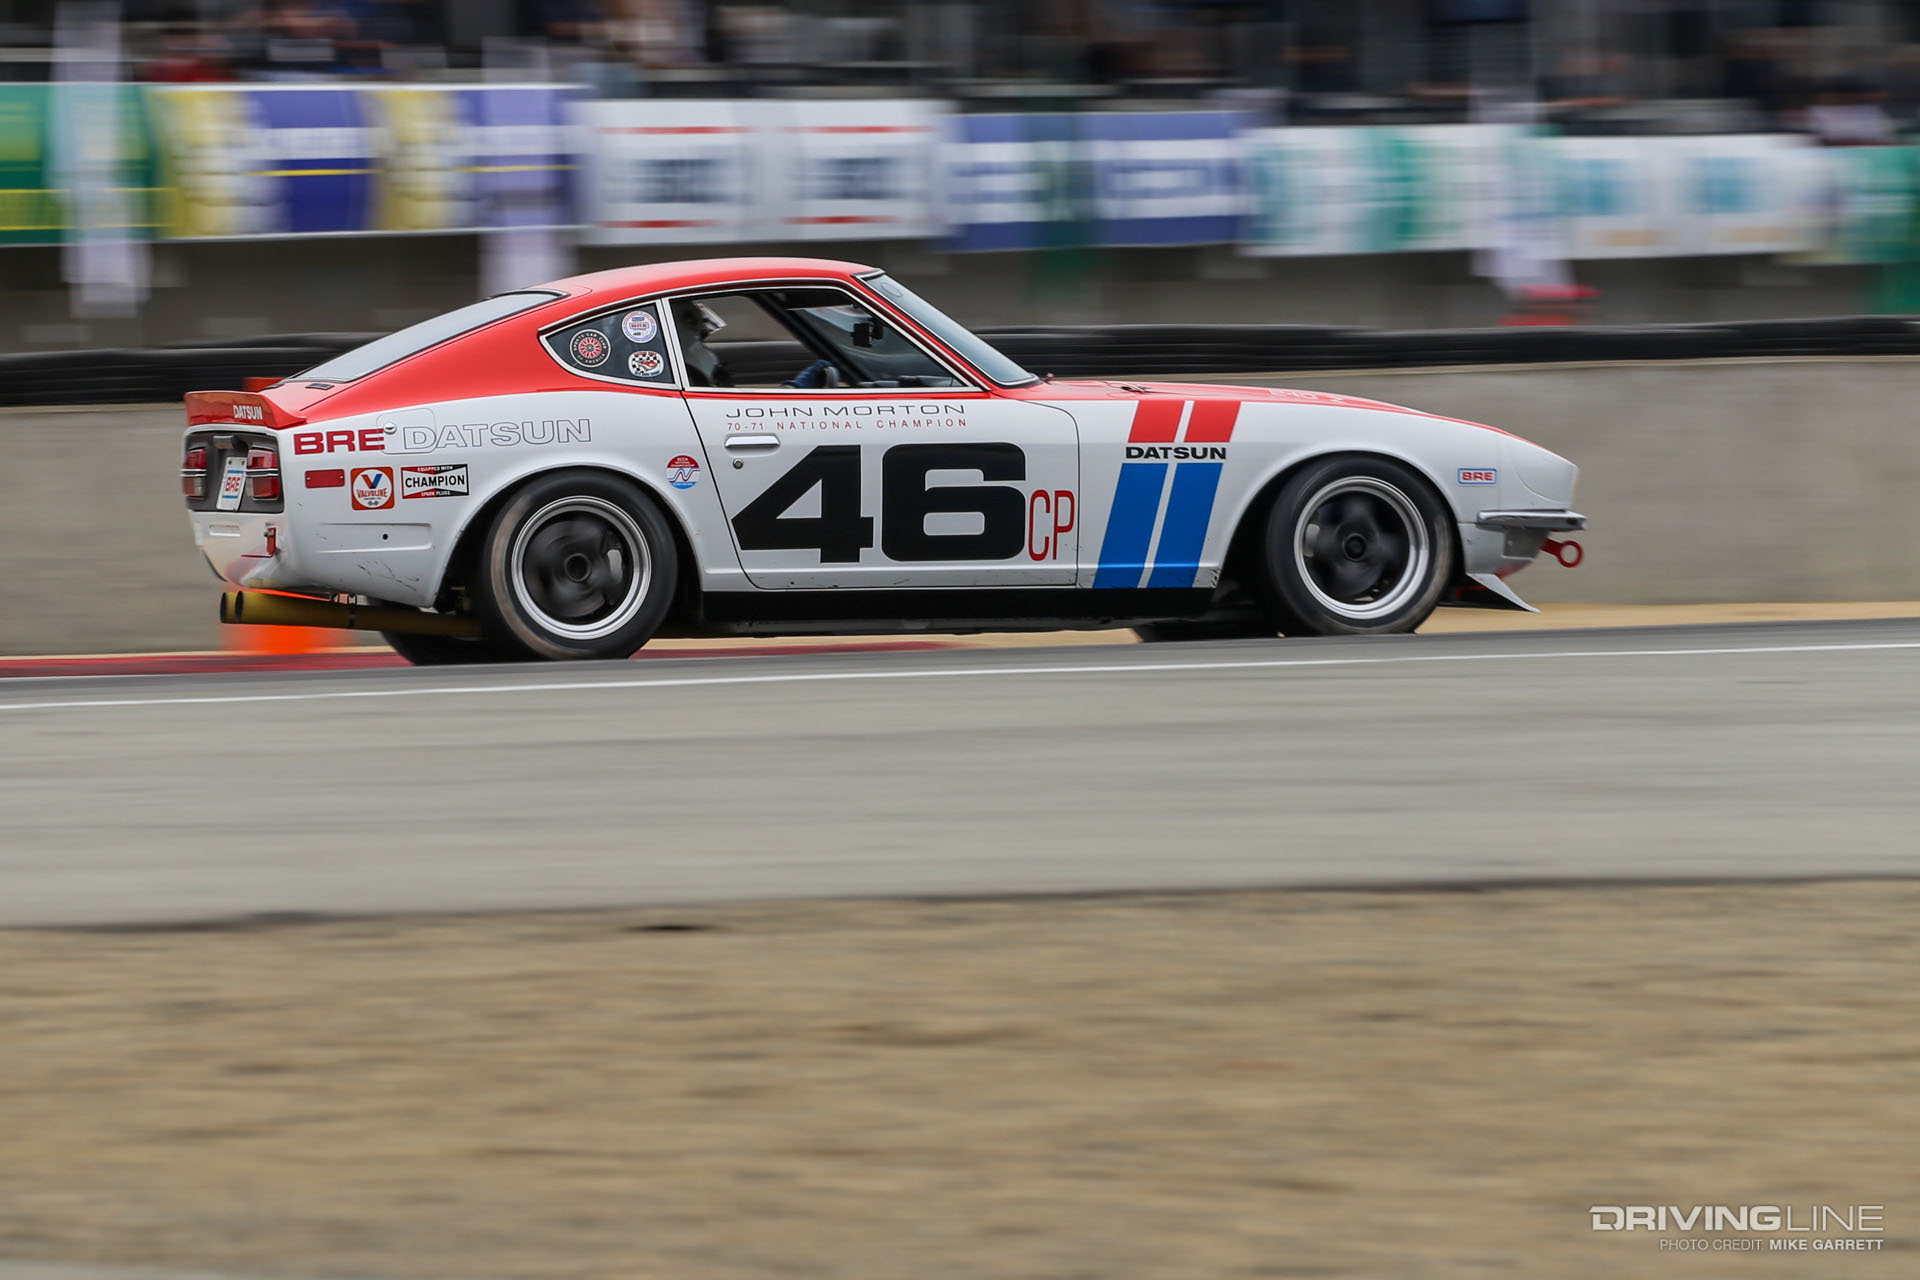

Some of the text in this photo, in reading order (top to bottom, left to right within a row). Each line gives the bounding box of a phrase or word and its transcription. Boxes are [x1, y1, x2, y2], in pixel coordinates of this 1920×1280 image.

[232, 404, 264, 420] DATSUN
[725, 404, 965, 419] JOHN MORTON
[727, 418, 967, 431] 70-71 NATIONAL CHAMPION
[293, 418, 592, 455] BRE DATSUN
[1125, 446, 1227, 460] DATSUN
[404, 474, 465, 488] CHAMPION
[1462, 471, 1494, 481] BRE
[225, 476, 241, 492] BRE
[356, 488, 388, 499] VALVOLINE
[730, 441, 1075, 563] 46 CP
